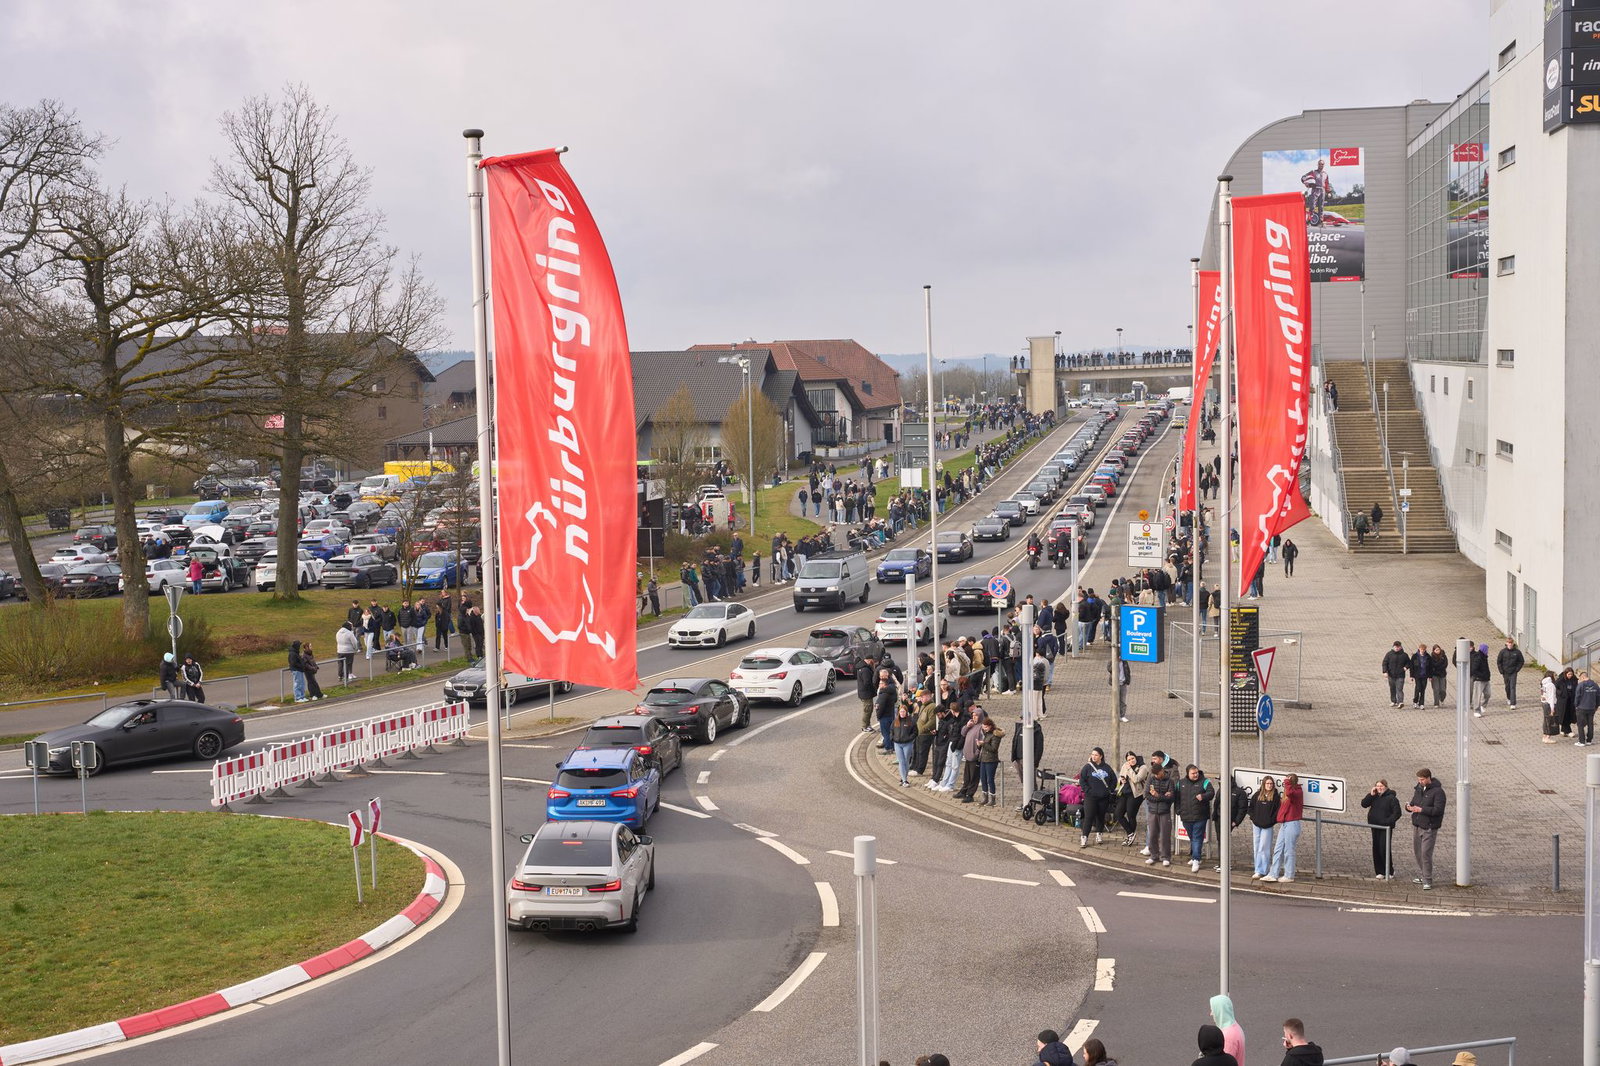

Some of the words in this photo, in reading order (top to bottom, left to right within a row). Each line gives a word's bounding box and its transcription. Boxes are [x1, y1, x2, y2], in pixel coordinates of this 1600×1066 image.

[1307, 232, 1346, 242] tRace-
[1308, 243, 1330, 254] nte,
[1309, 254, 1337, 264] iben.
[535, 178, 591, 564] nürburgring
[1133, 614, 1146, 630] P
[1126, 630, 1153, 638] Boulevard
